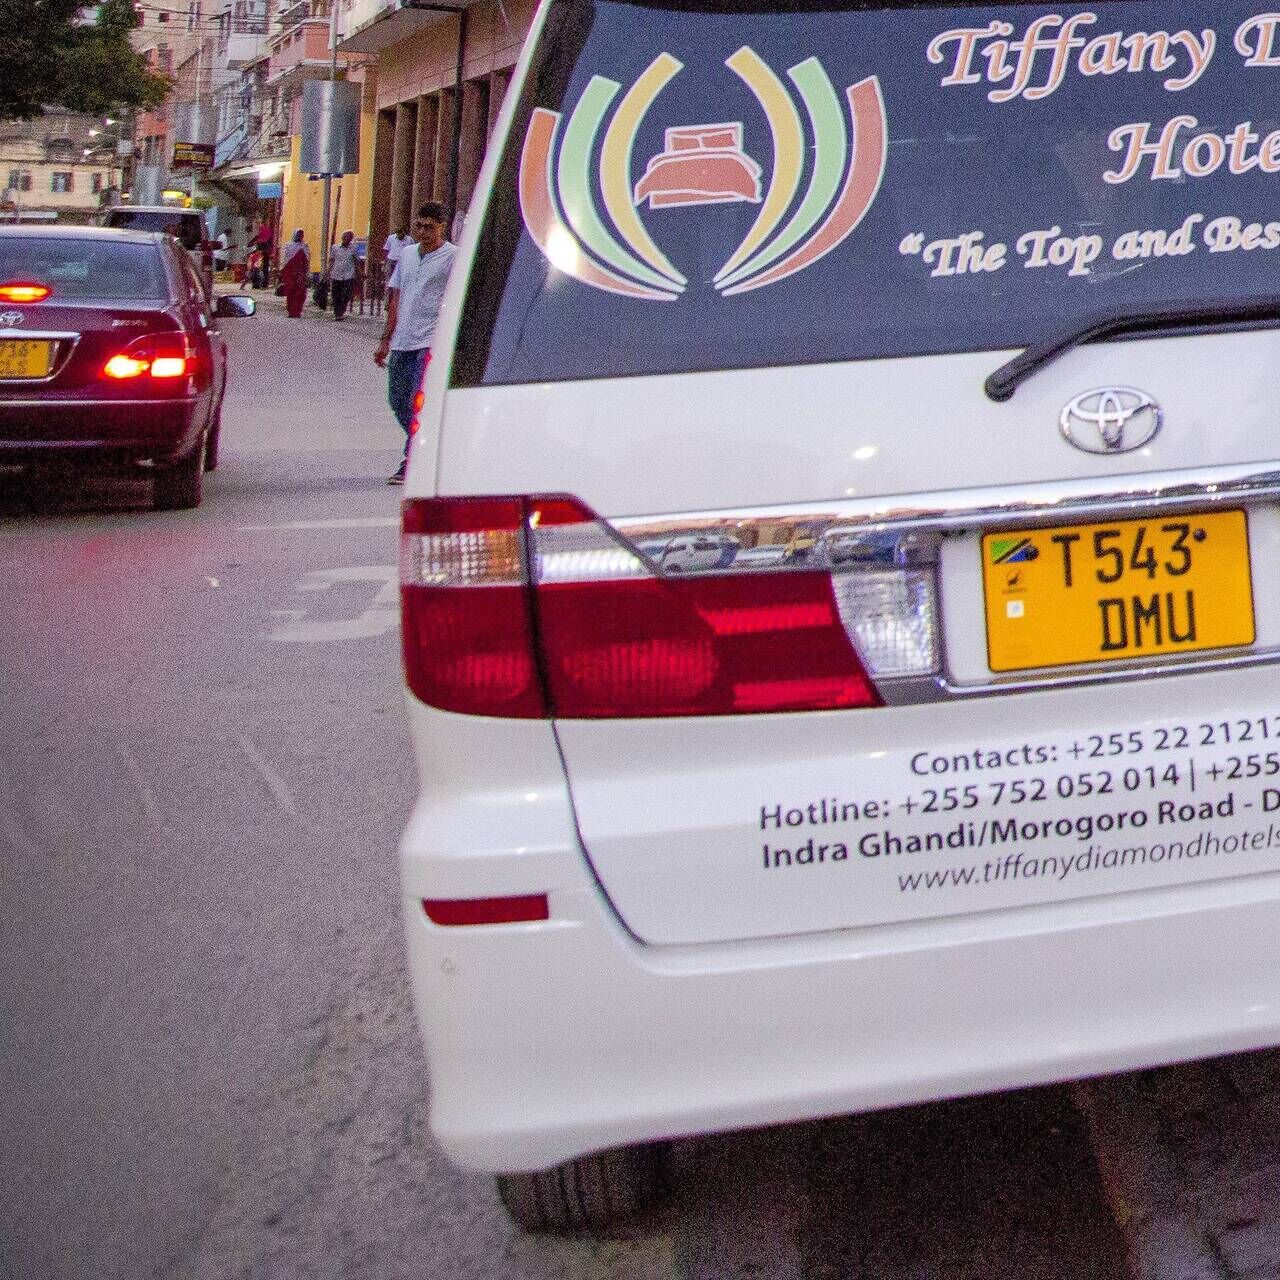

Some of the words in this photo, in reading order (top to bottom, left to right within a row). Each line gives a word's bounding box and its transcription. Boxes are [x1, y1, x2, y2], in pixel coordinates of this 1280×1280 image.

[925, 12, 1215, 104] Tiffany
[1016, 225, 1103, 278] Top
[1113, 213, 1201, 260] and
[1051, 533, 1081, 587] T
[1093, 523, 1193, 584] 543
[1098, 590, 1197, 652] DMU
[910, 744, 1058, 777] Contacts:
[1068, 730, 1144, 763] +255
[1154, 726, 1189, 752] 22
[759, 796, 890, 830] Hotline:
[899, 785, 979, 816] +255
[989, 778, 1047, 806] 752
[1056, 771, 1113, 800] 052
[1123, 764, 1180, 792] 014
[1206, 751, 1280, 782] +255
[762, 839, 848, 869] Indra
[858, 807, 1148, 858] Ghandi/Morogoro
[1158, 793, 1235, 825] Road
